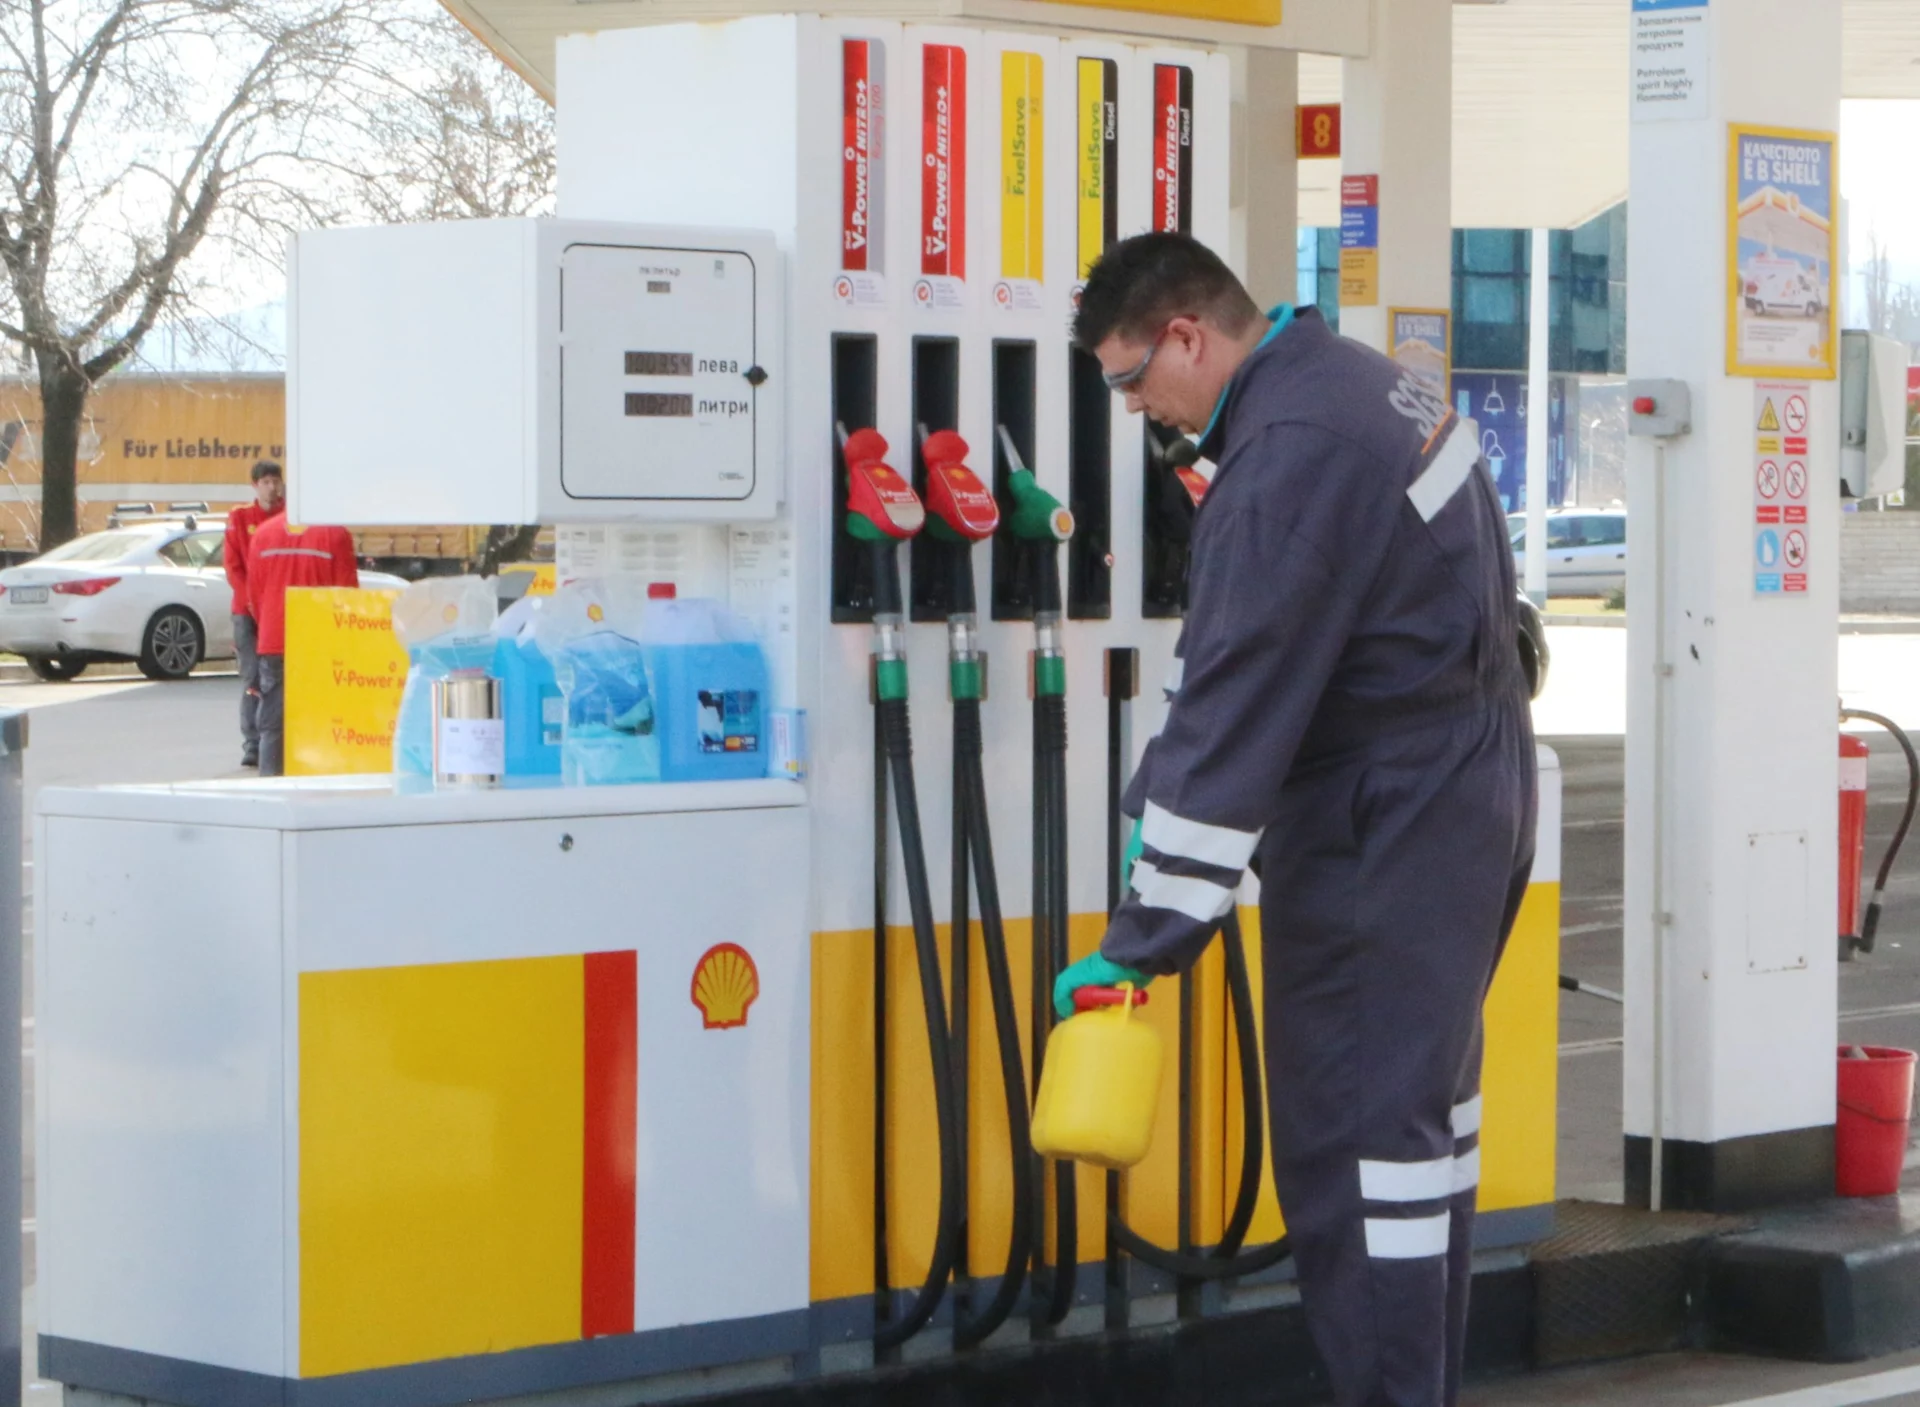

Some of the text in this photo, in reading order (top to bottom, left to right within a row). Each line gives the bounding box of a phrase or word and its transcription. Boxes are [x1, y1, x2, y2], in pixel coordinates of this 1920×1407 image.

[1637, 41, 1684, 53] продукти
[1637, 67, 1686, 78] Petroleum
[1637, 78, 1694, 91] spirit highly
[1105, 101, 1115, 140] Diesel
[1180, 108, 1190, 146] Diesel
[1313, 113, 1331, 149] 8
[1012, 96, 1026, 197] FuelSave
[1087, 102, 1101, 199] FuelSave
[1743, 141, 1820, 163] КАЧЕСТВОТО
[1772, 161, 1820, 186] SHELL
[852, 153, 866, 250] V-Power
[932, 160, 946, 255] V-Power
[698, 360, 738, 373] лева
[698, 401, 749, 418] литри
[123, 438, 158, 459] Für
[166, 437, 262, 459] Liebherr
[333, 670, 393, 688] V-Power
